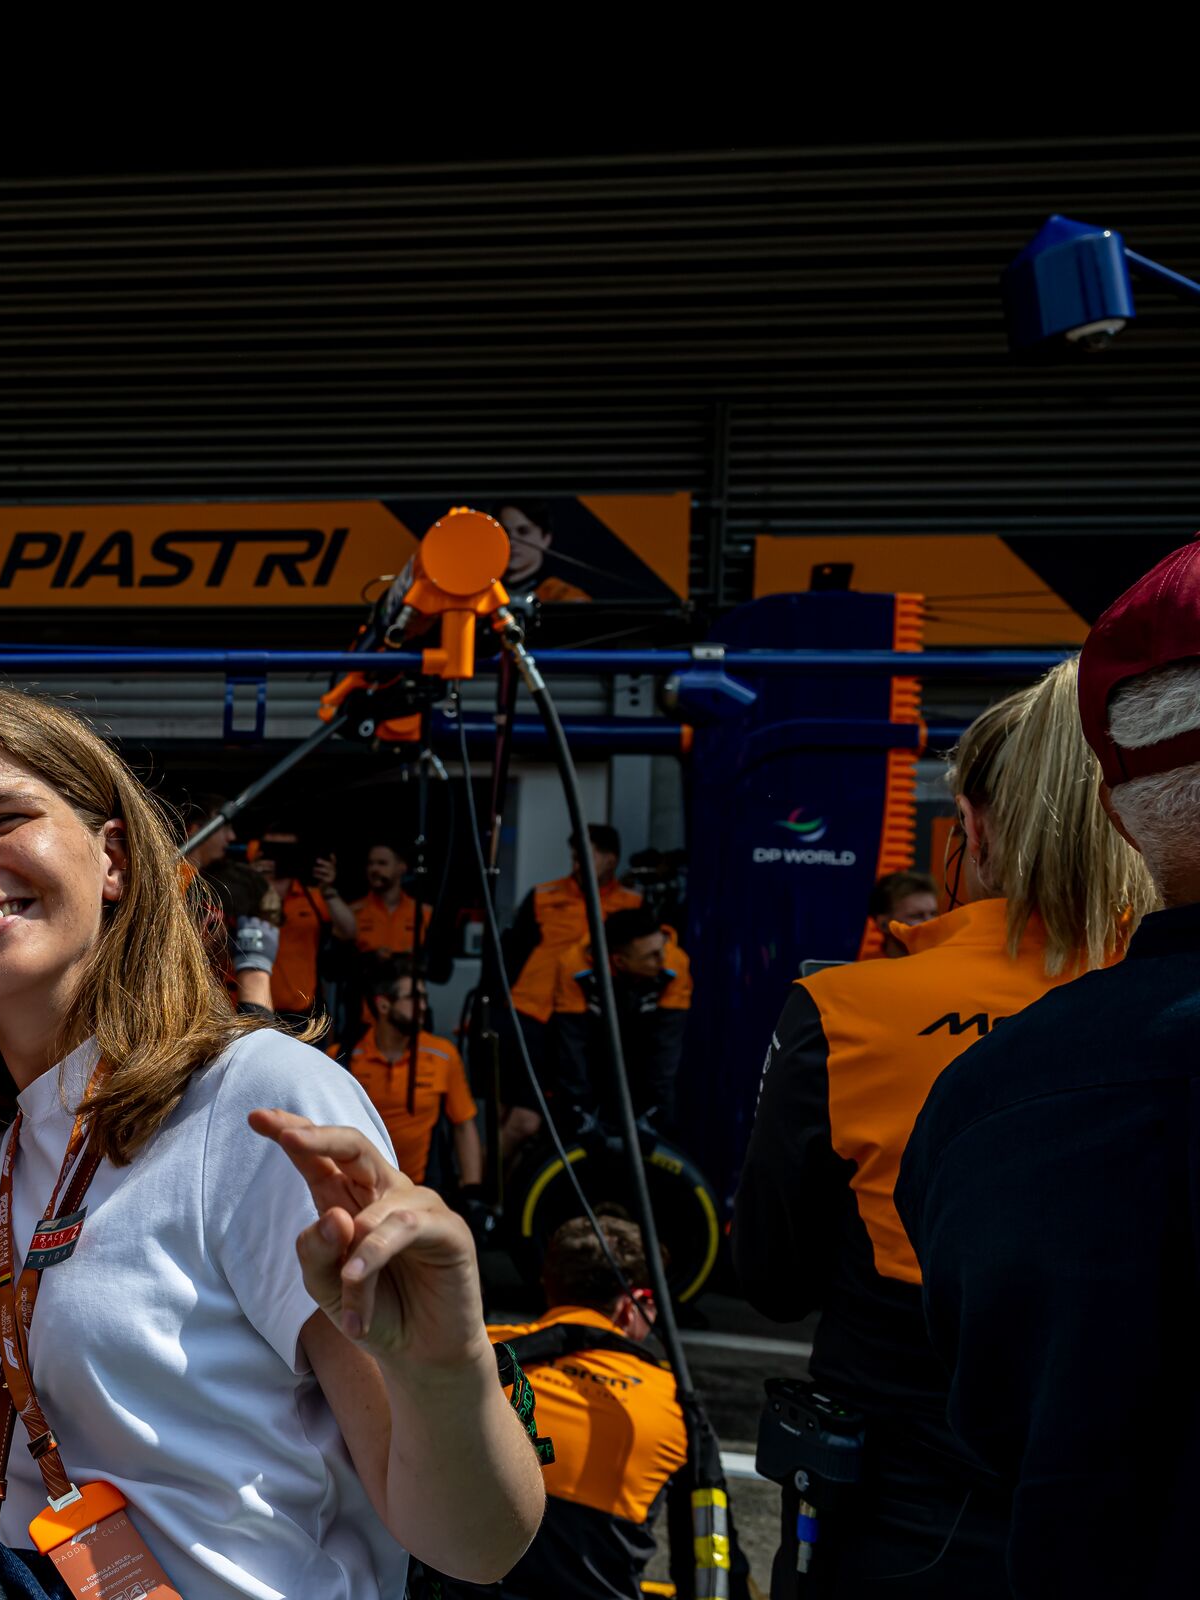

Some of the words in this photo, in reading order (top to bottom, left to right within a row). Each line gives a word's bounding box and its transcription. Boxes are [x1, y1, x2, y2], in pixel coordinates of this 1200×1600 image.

[752, 847, 782, 863] DP
[783, 847, 857, 866] WORLD
[33, 1231, 65, 1244] TRACK
[54, 1536, 99, 1564] PADDOCK
[102, 1519, 127, 1537] CLUB
